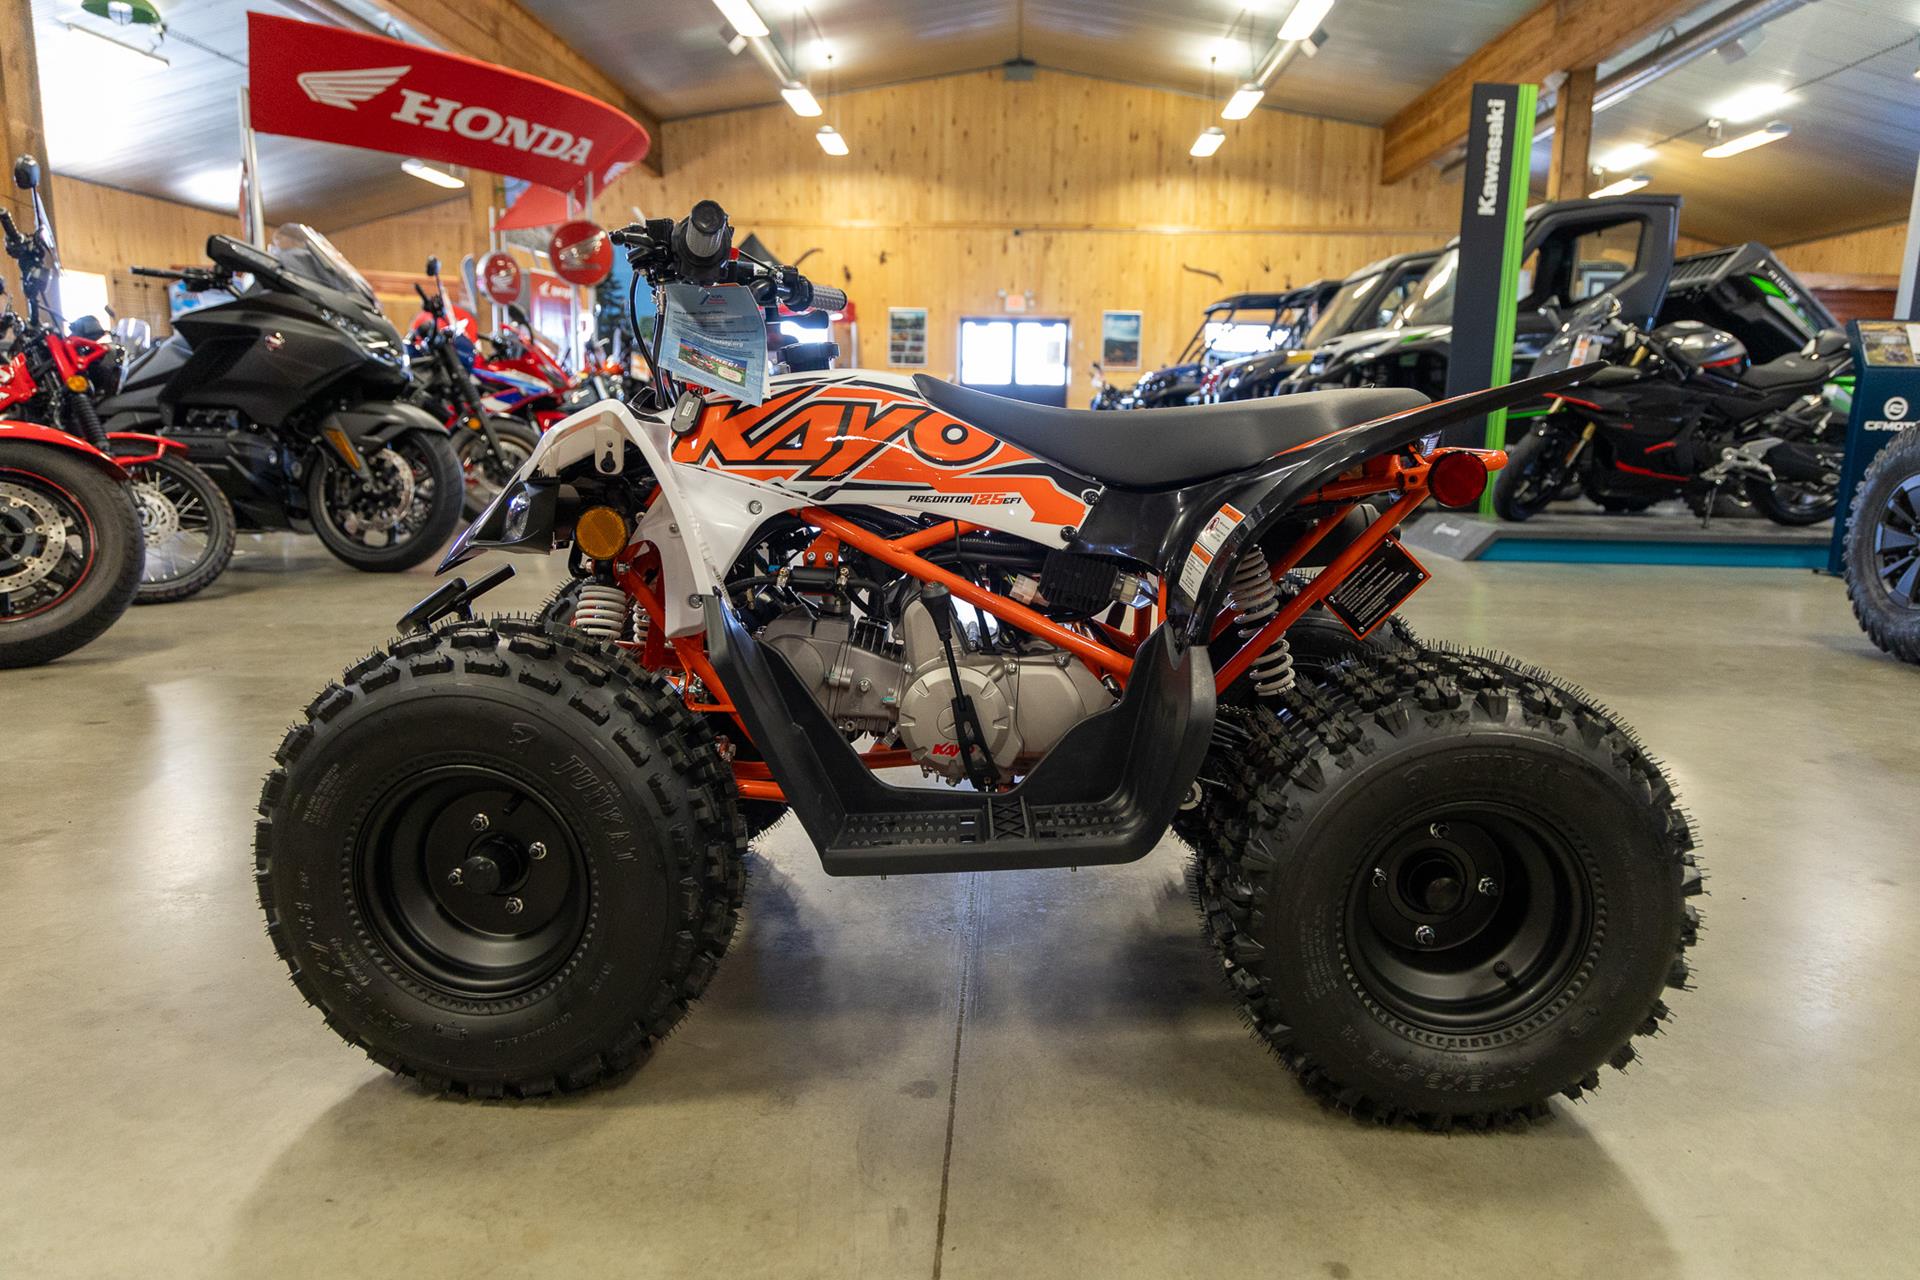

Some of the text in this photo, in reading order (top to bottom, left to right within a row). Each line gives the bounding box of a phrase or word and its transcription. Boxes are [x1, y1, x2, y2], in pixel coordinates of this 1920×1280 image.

[391, 88, 593, 166] HONDA
[1477, 99, 1506, 216] Kawasaki
[672, 385, 1001, 481] KAYO
[1863, 420, 1916, 432] CFMOT
